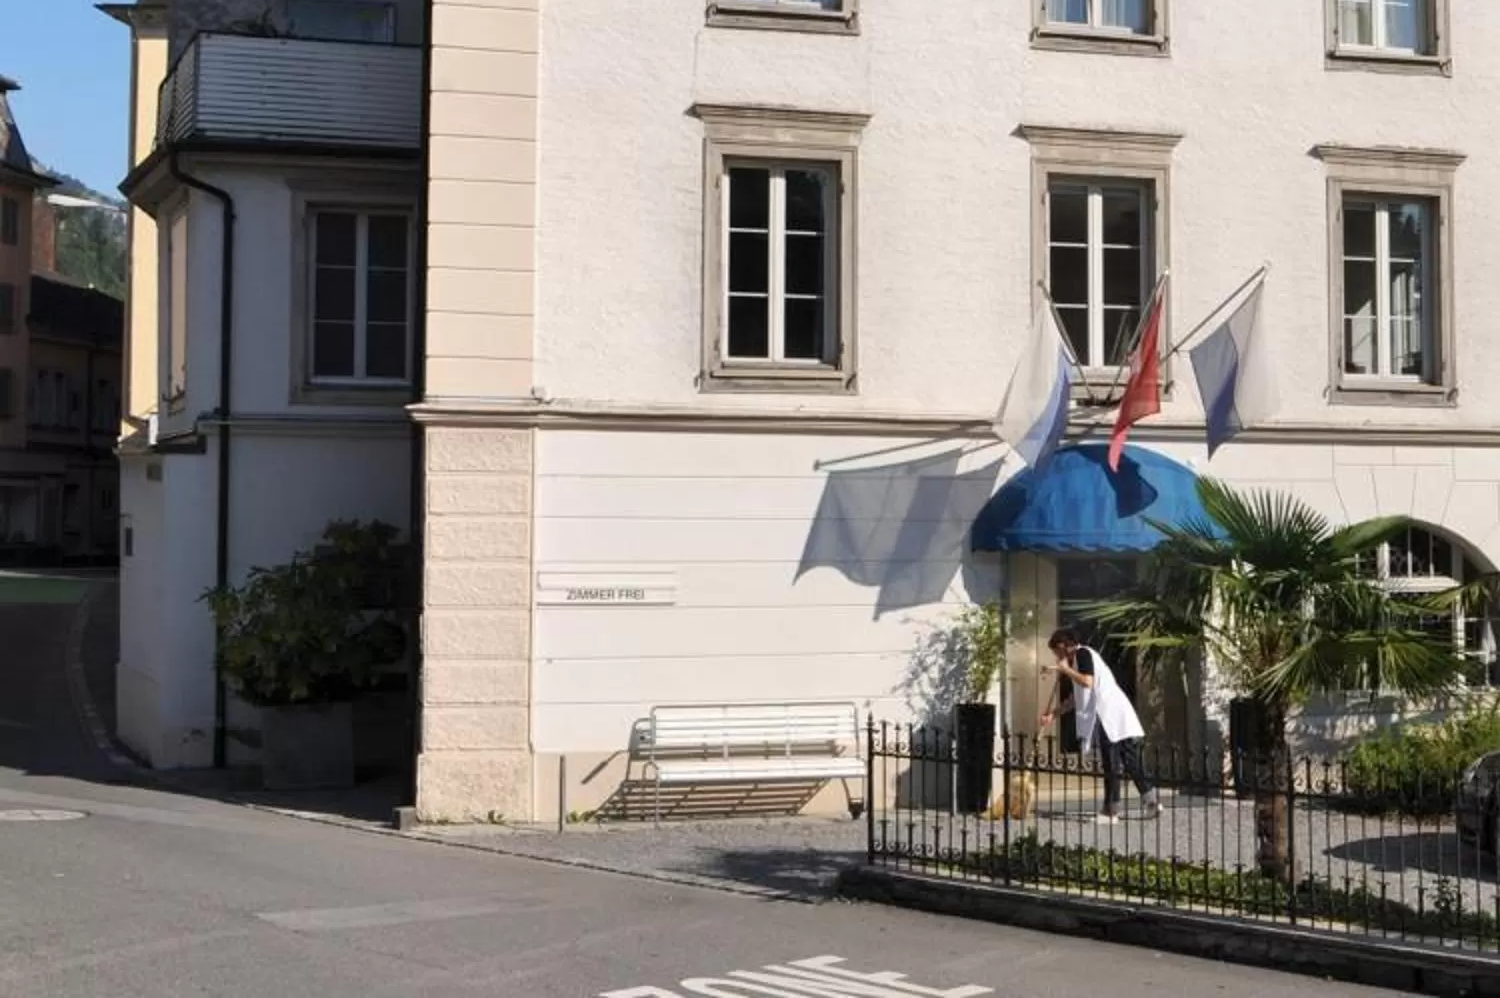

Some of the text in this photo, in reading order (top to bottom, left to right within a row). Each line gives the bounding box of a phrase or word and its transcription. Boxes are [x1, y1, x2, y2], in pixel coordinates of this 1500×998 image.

[565, 587, 645, 601] ZIMMER FREI
[597, 954, 995, 998] ONE
